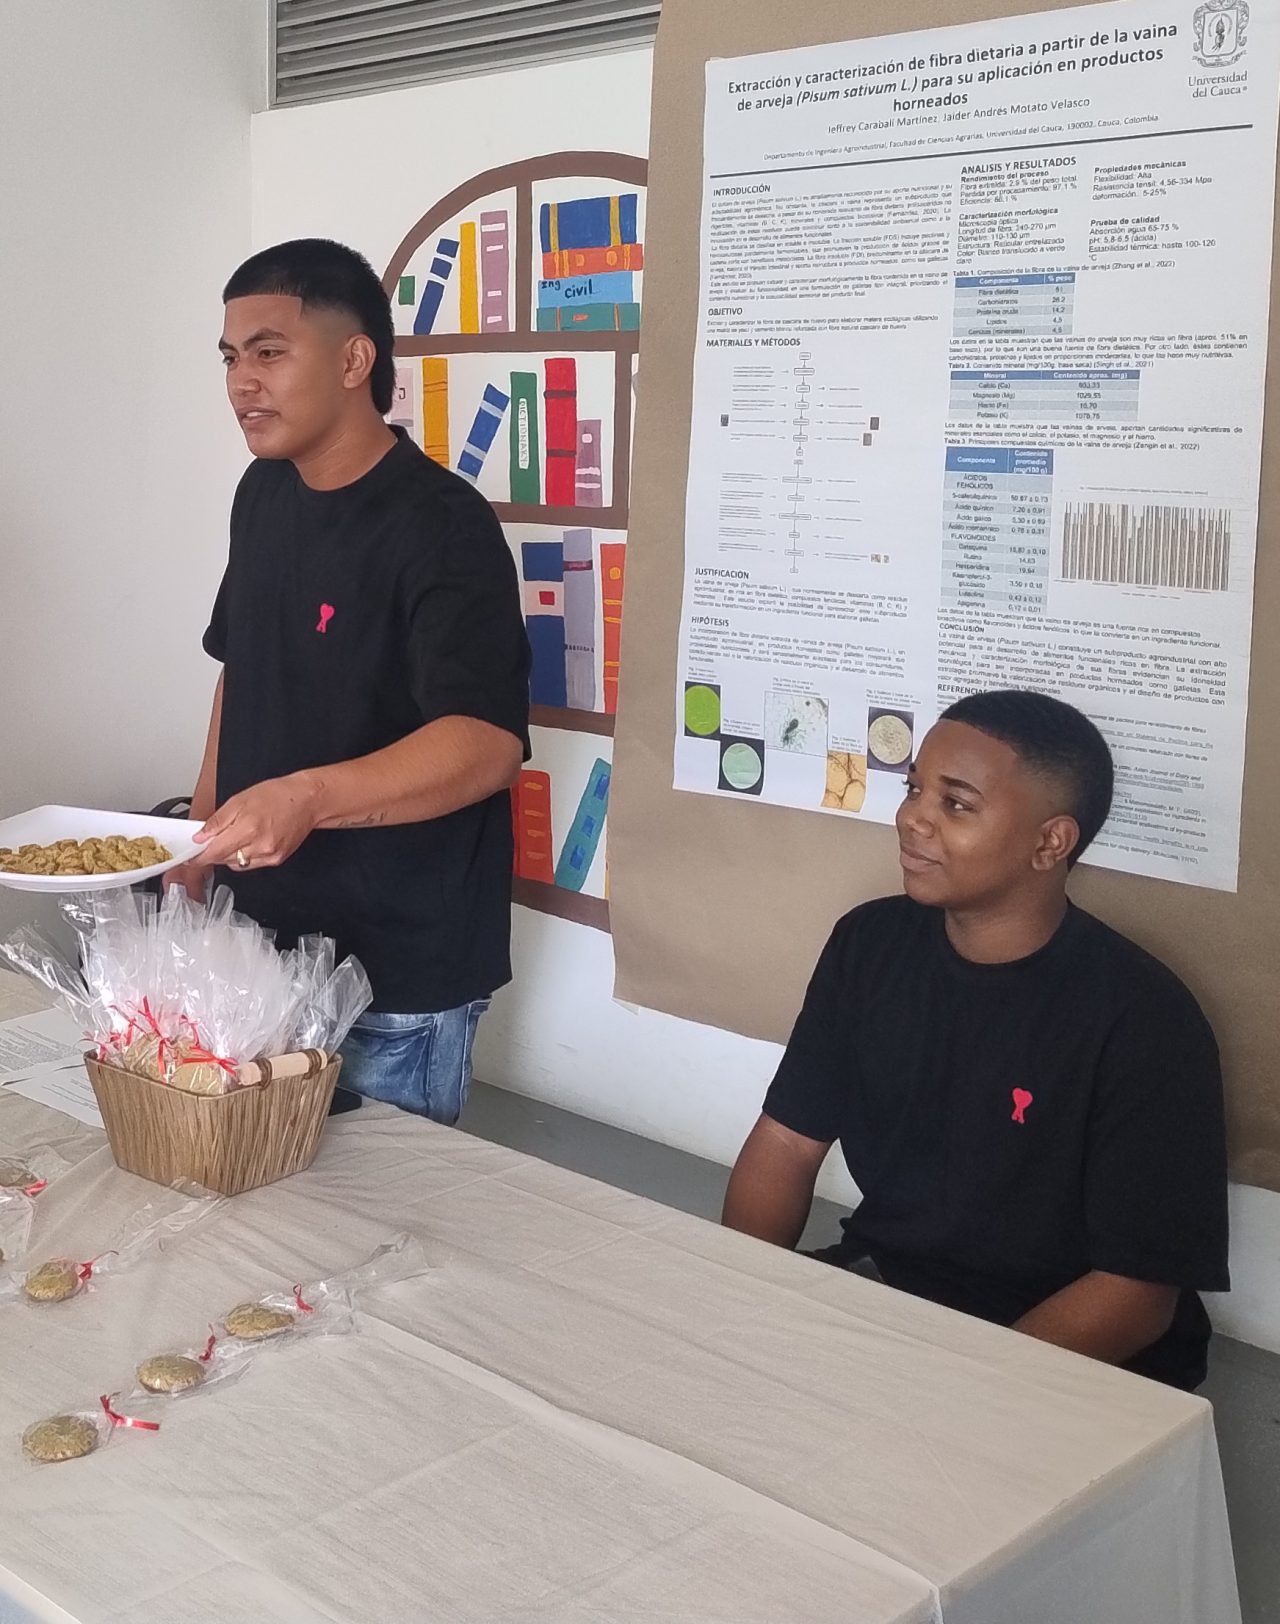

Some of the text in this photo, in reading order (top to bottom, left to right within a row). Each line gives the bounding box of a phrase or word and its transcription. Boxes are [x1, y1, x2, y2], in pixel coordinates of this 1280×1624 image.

[729, 25, 1177, 93] Extracción y caracterización de fibra dietaria a partir de la vaina
[737, 50, 1163, 111] de arveja (Pisum sativum L.) para su aplicación en productos
[1188, 72, 1247, 86] Universidad
[1192, 86, 1240, 98] del Cauca
[894, 93, 967, 111] horneados
[858, 118, 893, 130] Carabalí
[943, 111, 970, 121] Jaider
[973, 107, 1007, 118] Andrés
[1010, 104, 1047, 114] Motato
[1051, 100, 1089, 110] Velasco
[1005, 162, 1010, 170] Y
[1013, 157, 1076, 170] RESULTADOS
[1095, 161, 1186, 174] Propiedades mecánicas
[961, 174, 1004, 182] Rendimiento
[1019, 171, 1048, 179] proceso
[714, 185, 770, 196] INTRODUCCIÓN
[564, 279, 593, 298] civil
[708, 307, 742, 316] OBJETIVO
[707, 339, 752, 347] MATERIALES
[761, 336, 800, 346] MÉTODOS
[692, 615, 729, 626] HIPÓTESIS
[940, 623, 984, 632] CONCLUSIÓN
